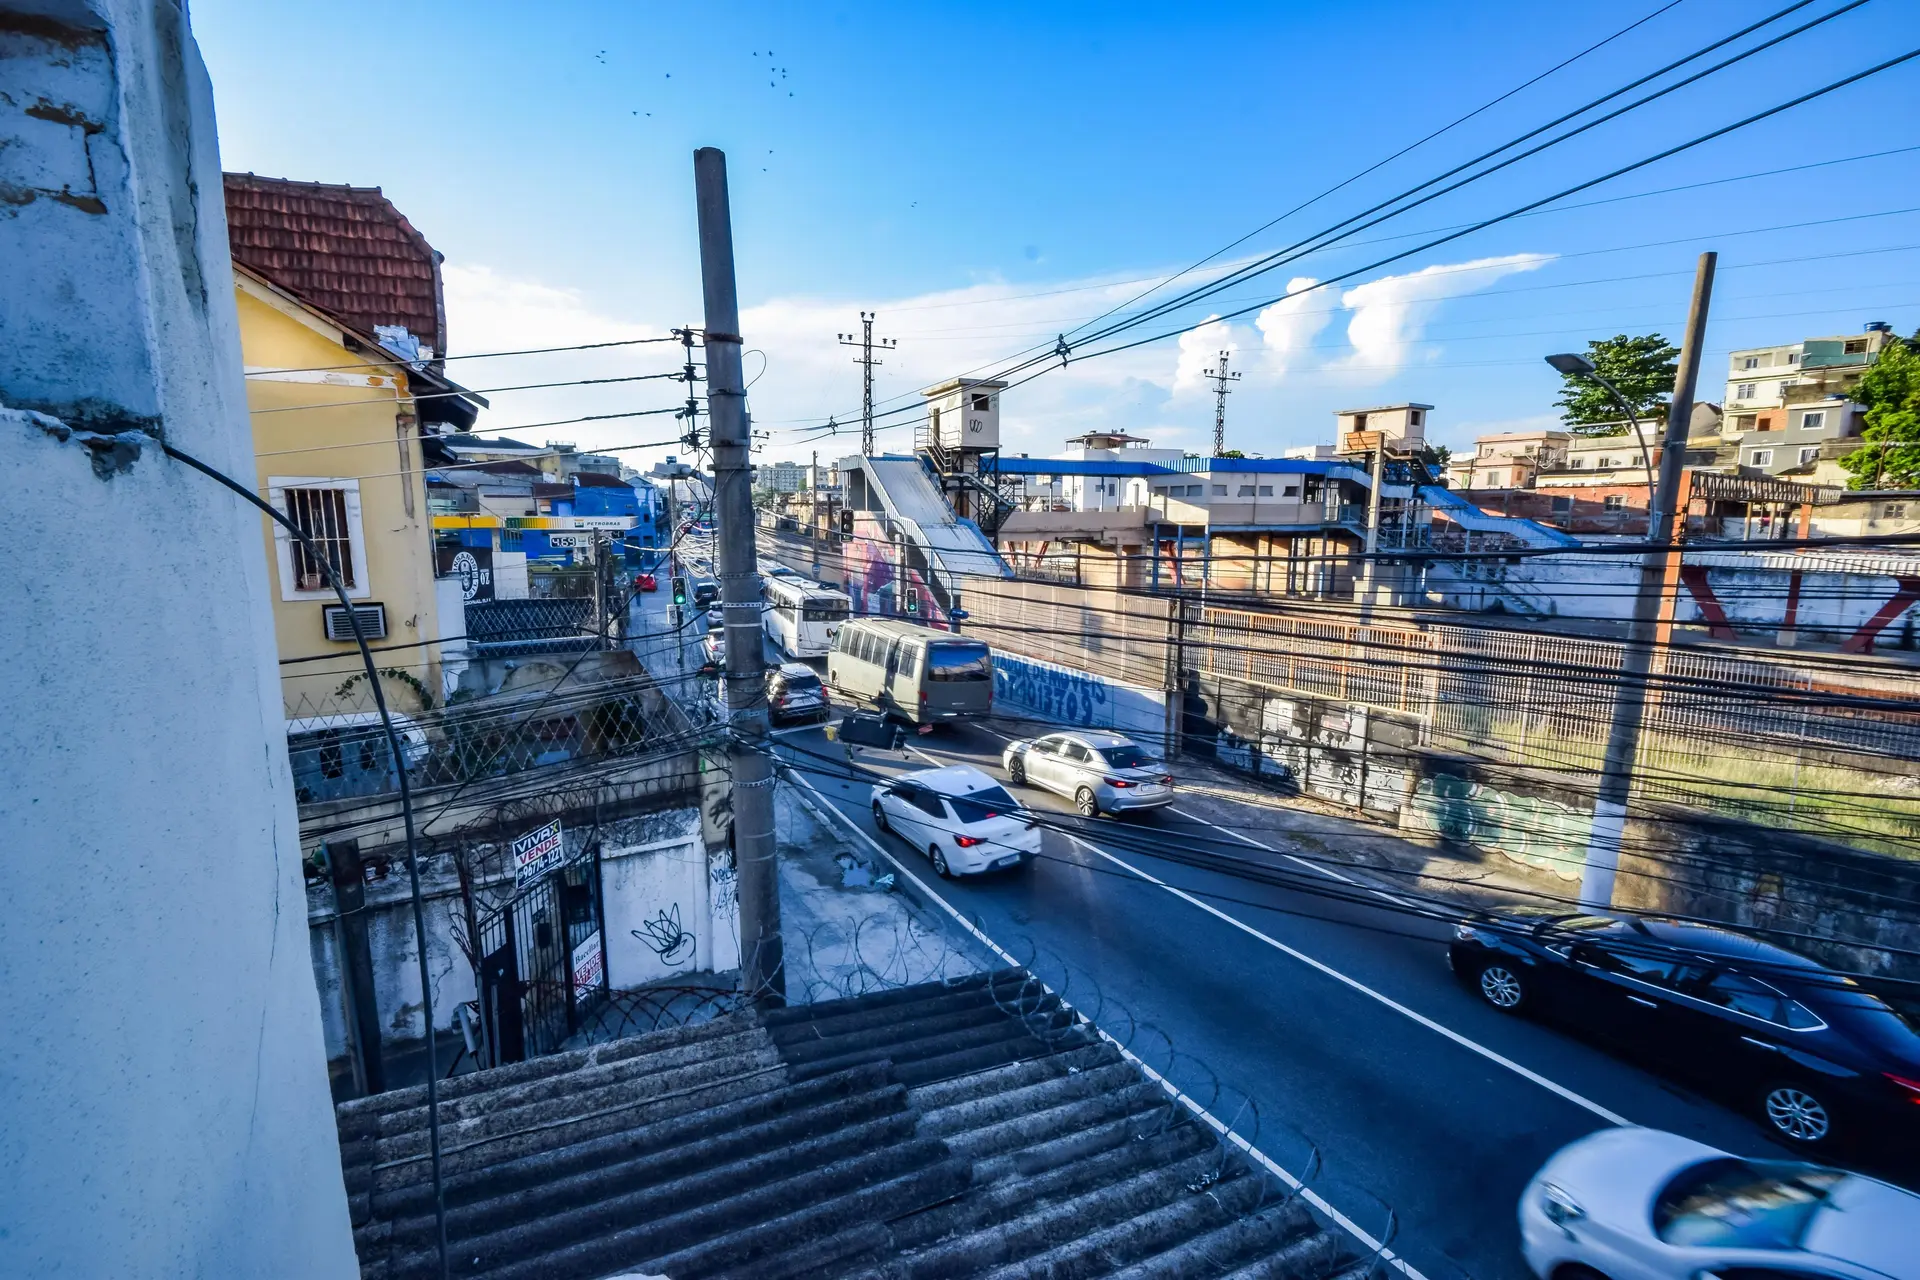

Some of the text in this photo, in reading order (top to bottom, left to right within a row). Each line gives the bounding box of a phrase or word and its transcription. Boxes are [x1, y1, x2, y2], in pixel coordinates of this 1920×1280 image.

[516, 823, 558, 853] VIVAX
[520, 834, 558, 865] VENDE
[576, 952, 601, 980] VENDE
